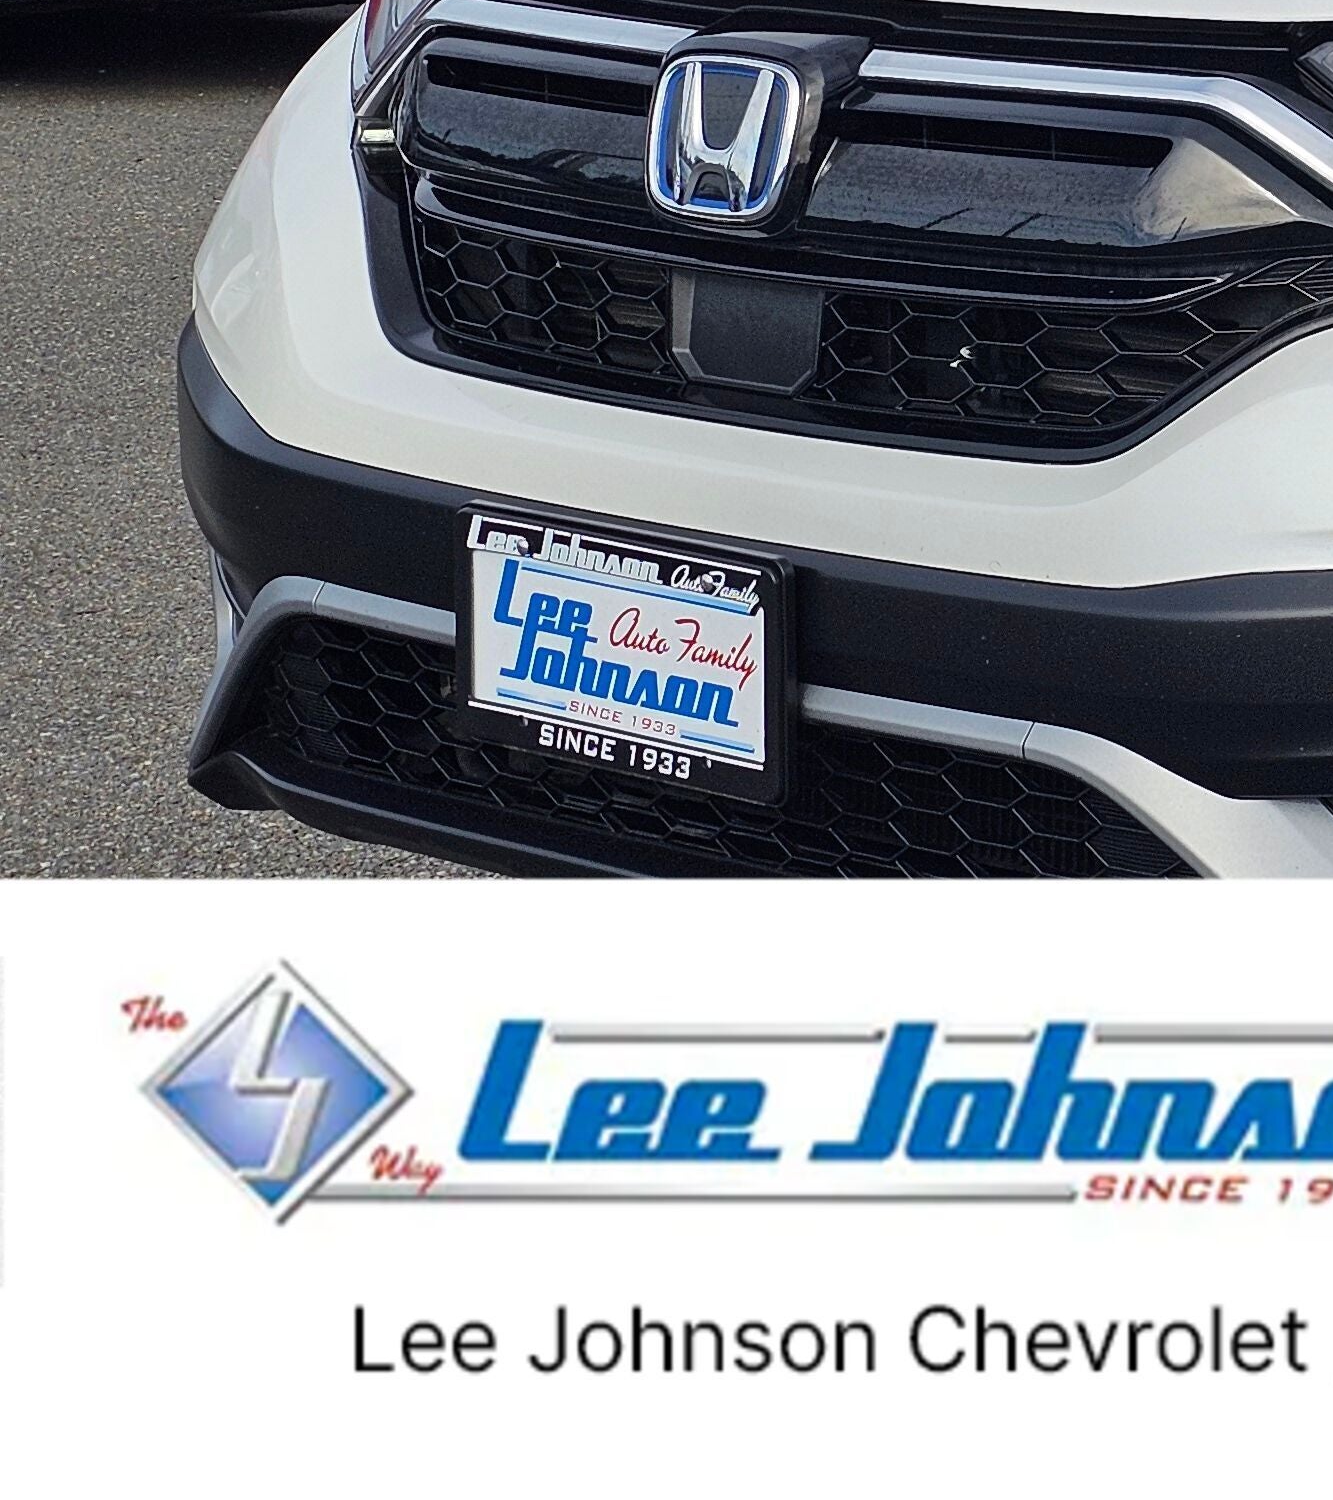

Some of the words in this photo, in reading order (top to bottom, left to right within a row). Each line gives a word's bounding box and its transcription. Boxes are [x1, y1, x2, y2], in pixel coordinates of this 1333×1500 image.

[493, 558, 598, 644] Lee
[532, 527, 663, 585] Johnson
[670, 564, 713, 594] Aut
[708, 570, 760, 615] Family
[499, 624, 739, 728] Johnson
[609, 607, 671, 655] Auto
[674, 618, 758, 692] Family
[538, 723, 617, 762] SINCE
[629, 744, 691, 780] 1933
[568, 700, 623, 724] SINCE
[632, 715, 677, 736] 1933
